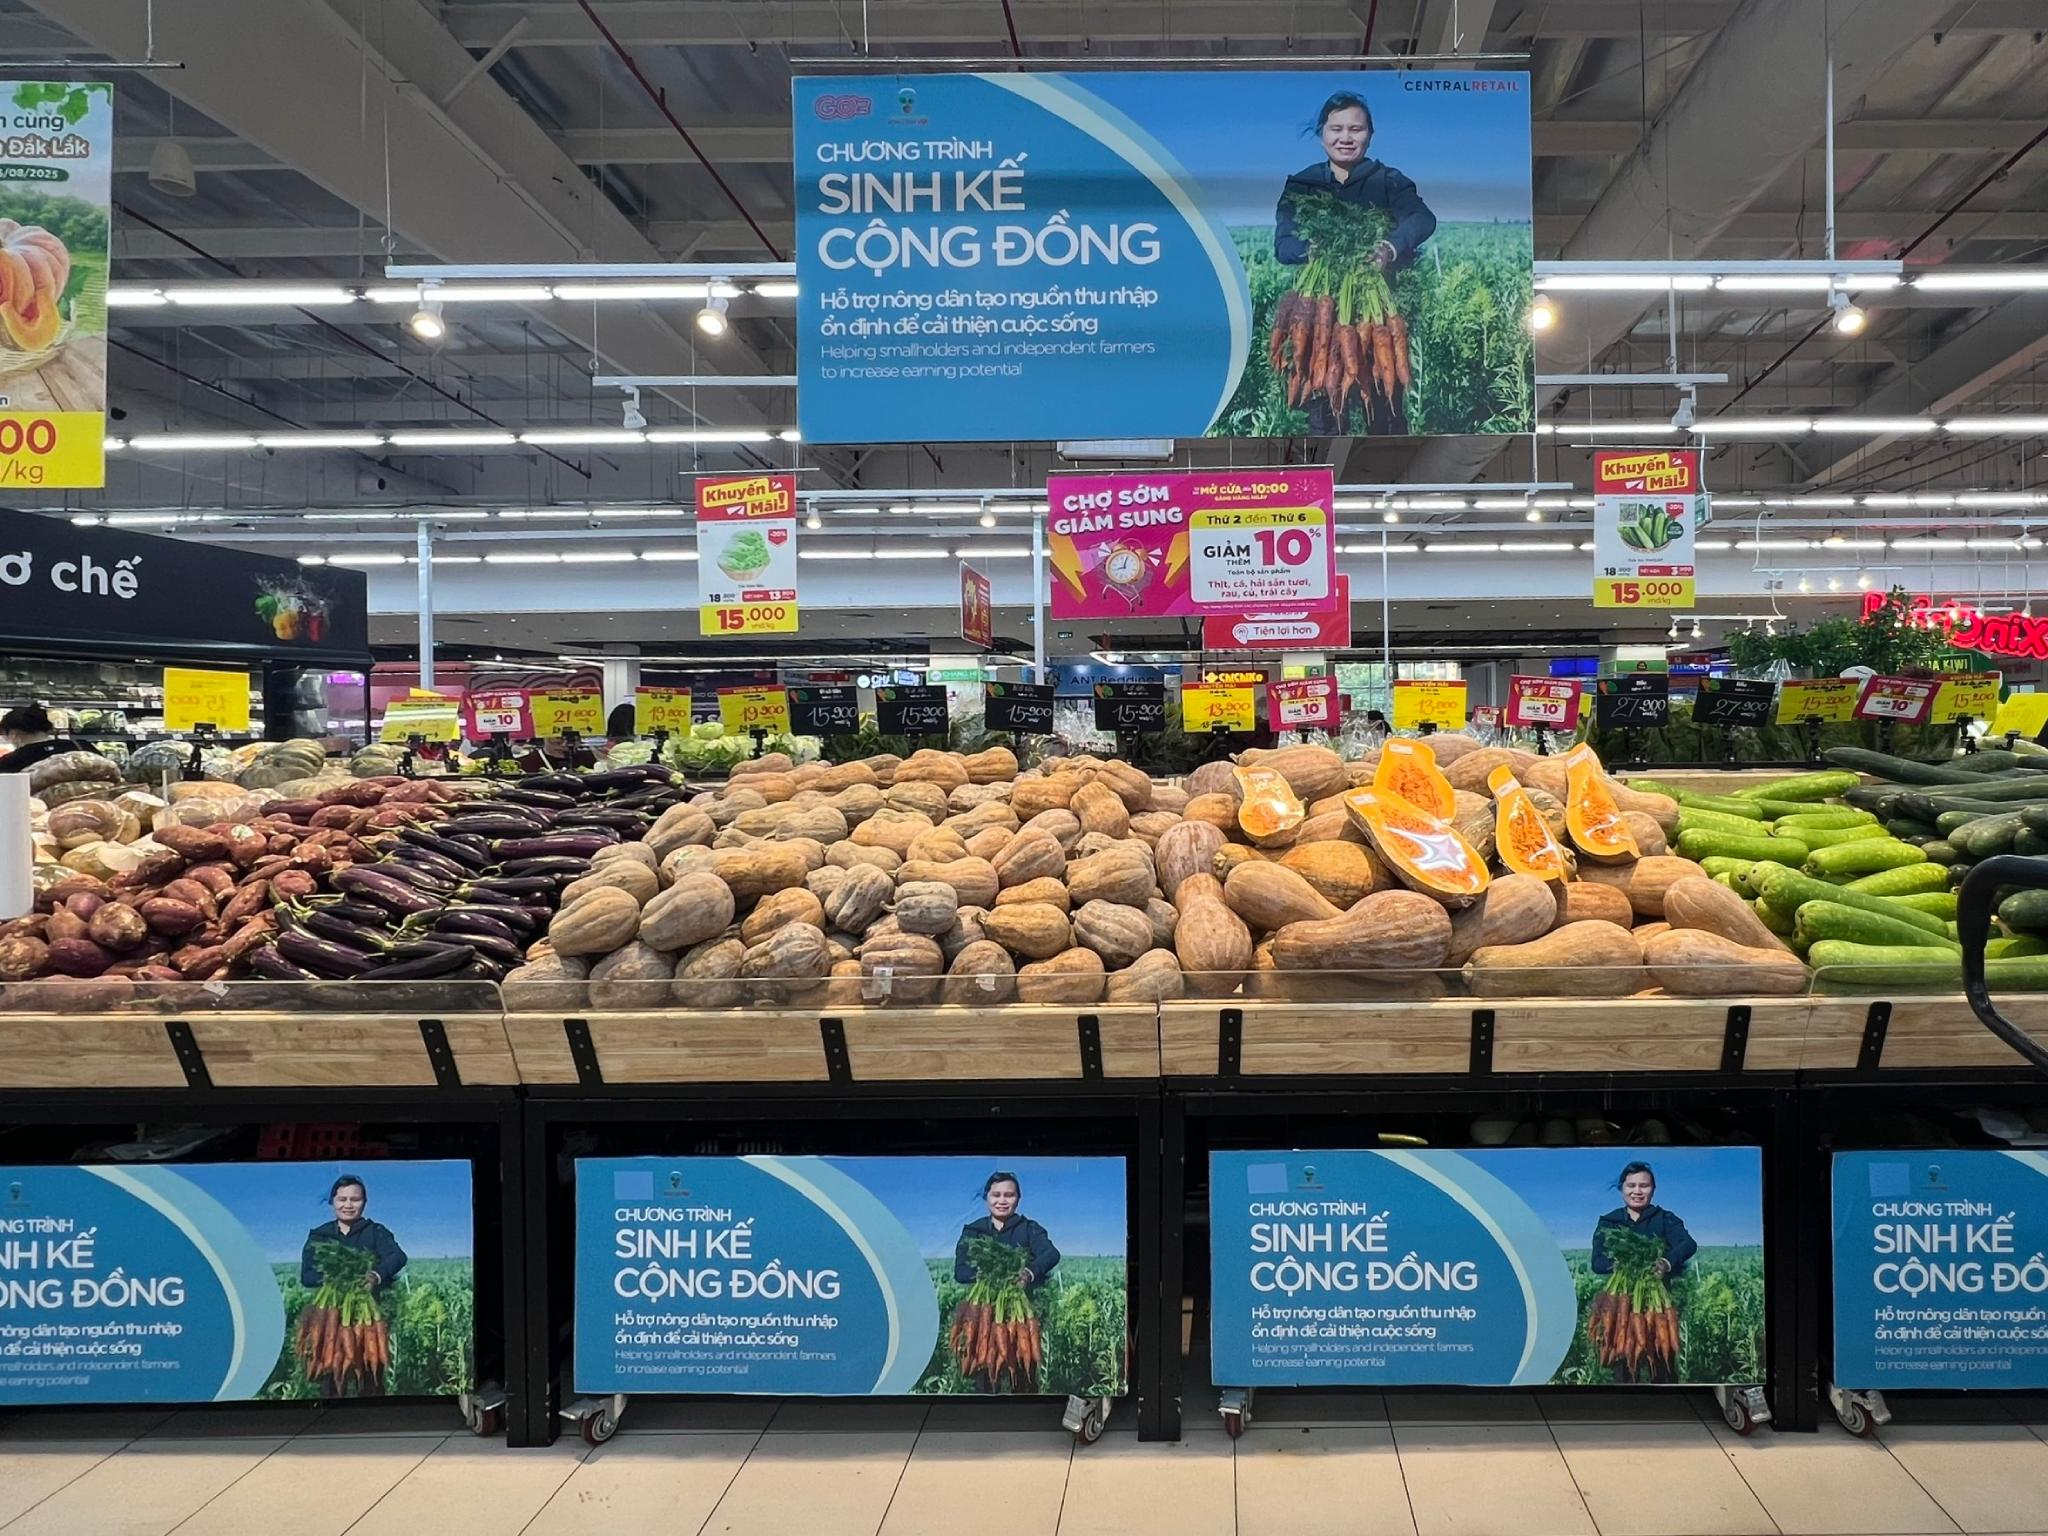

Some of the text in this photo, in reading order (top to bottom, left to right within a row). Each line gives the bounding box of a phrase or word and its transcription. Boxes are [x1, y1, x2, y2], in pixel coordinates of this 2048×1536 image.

[1404, 80, 1519, 92] CENTRALRETAIL
[8, 135, 87, 155] Đắk Lắk
[816, 136, 993, 163] CHƯƠNG TRÌNH
[818, 151, 1029, 214] SINH KẾ
[818, 208, 1161, 278] CỘNG ĐỒNG
[820, 284, 1158, 313] Hỗ trợ nông dân tạo nguồn thu nhập
[820, 311, 1099, 339] ổn định để cải thiện cuộc sống
[821, 339, 1156, 361] Helping smallholders and independent farmers
[821, 361, 1023, 380] to increase earning potential
[1604, 456, 1666, 476] Khuyến
[1220, 482, 1243, 494] CỬA
[1251, 483, 1289, 494] 10:00
[1650, 467, 1686, 489] Mãi!
[706, 481, 766, 503] Khuyến
[1063, 490, 1113, 512] CHỢ
[1118, 484, 1169, 506] SỚM
[1054, 507, 1183, 534] GIẢM SUNG
[1206, 513, 1306, 525] Thứ 2 đến Thứ 6
[1203, 540, 1251, 558] GIẢM
[1226, 558, 1251, 566] THÊM
[51, 555, 143, 600] chế
[1280, 588, 1298, 597] cây
[1611, 582, 1682, 604] 15.000
[716, 607, 785, 630] 15.000
[1253, 627, 1275, 636] Tiện
[1303, 703, 1319, 714] 10
[1542, 703, 1559, 714] 10
[1891, 700, 1909, 711] 10
[497, 714, 514, 725] 10
[615, 1204, 732, 1222] CHƯƠNG TRÌNH
[1249, 1199, 1366, 1217] CHƯƠNG TRÌNH
[1872, 1199, 1992, 1217] CHƯƠNG TRÌNH
[26, 1216, 73, 1233] TRÌNH
[1250, 1210, 1390, 1253] SINH KẾ
[1873, 1211, 2016, 1254] SINH KẾ
[47, 1226, 98, 1269] KẾ
[615, 1217, 755, 1259] SINH KẾ
[614, 1258, 841, 1303] CỘNG ĐỒNG
[1250, 1251, 1478, 1297] CỘNG ĐỒNG
[1873, 1256, 1984, 1298] CỘNG
[71, 1266, 185, 1308] ĐỒNG
[691, 1312, 716, 1326] dân
[717, 1314, 738, 1329] tạo
[783, 1313, 804, 1327] thu
[805, 1311, 838, 1329] nhập
[1273, 1308, 1292, 1322] trợ
[1292, 1306, 1326, 1322] nông
[1328, 1306, 1352, 1320] dân
[1354, 1307, 1376, 1323] tạo
[1420, 1306, 1442, 1319] thu
[1443, 1305, 1476, 1322] nhập
[1271, 1325, 1299, 1340] định
[1338, 1324, 1370, 1340] thiện
[1371, 1325, 1402, 1340] cuộc
